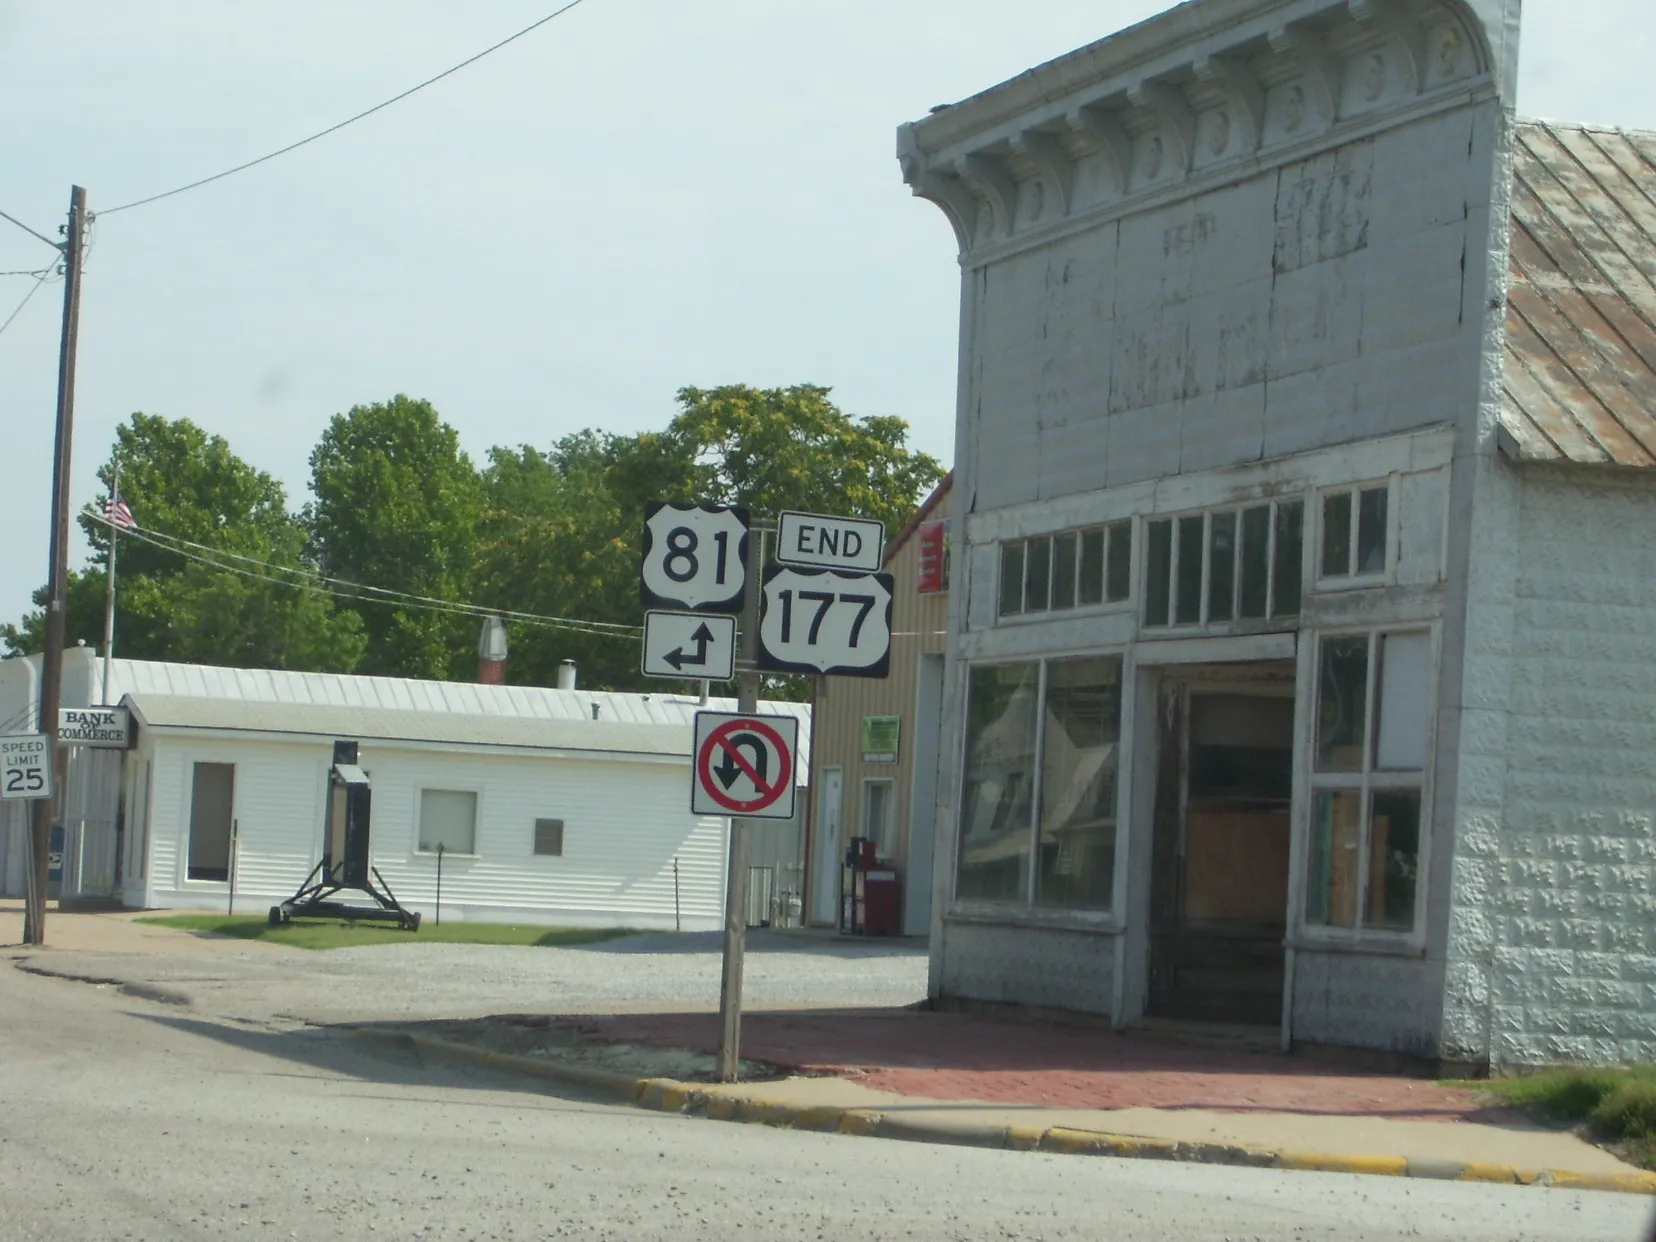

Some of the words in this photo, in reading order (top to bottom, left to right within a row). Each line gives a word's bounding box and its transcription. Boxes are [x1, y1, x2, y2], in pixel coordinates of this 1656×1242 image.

[797, 525, 862, 558] END
[663, 526, 728, 585] 81
[778, 589, 876, 648] 177
[66, 712, 116, 724] BANK
[58, 728, 124, 740] COMMERCE
[2, 742, 44, 754] SPEED
[7, 755, 40, 766] LIMIT
[6, 768, 44, 792] 25
